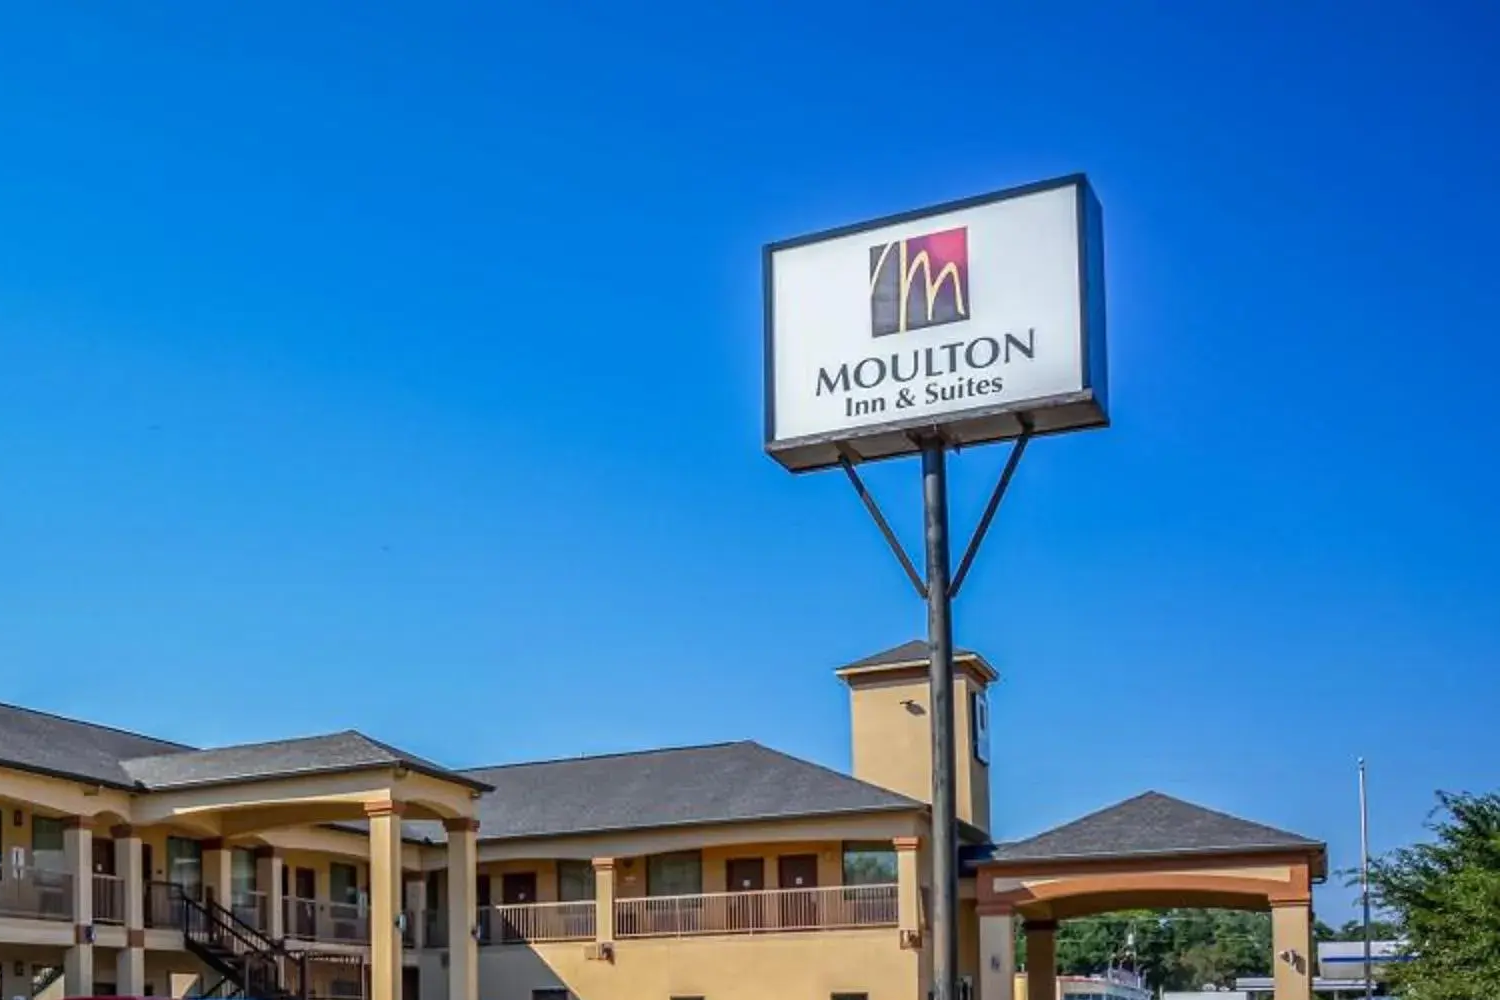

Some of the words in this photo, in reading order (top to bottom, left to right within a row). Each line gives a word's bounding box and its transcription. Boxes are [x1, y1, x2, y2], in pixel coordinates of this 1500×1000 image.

[815, 328, 1036, 397] MOULTON
[844, 395, 886, 417] Inn
[895, 387, 917, 410] &
[924, 376, 1003, 405] Suites
